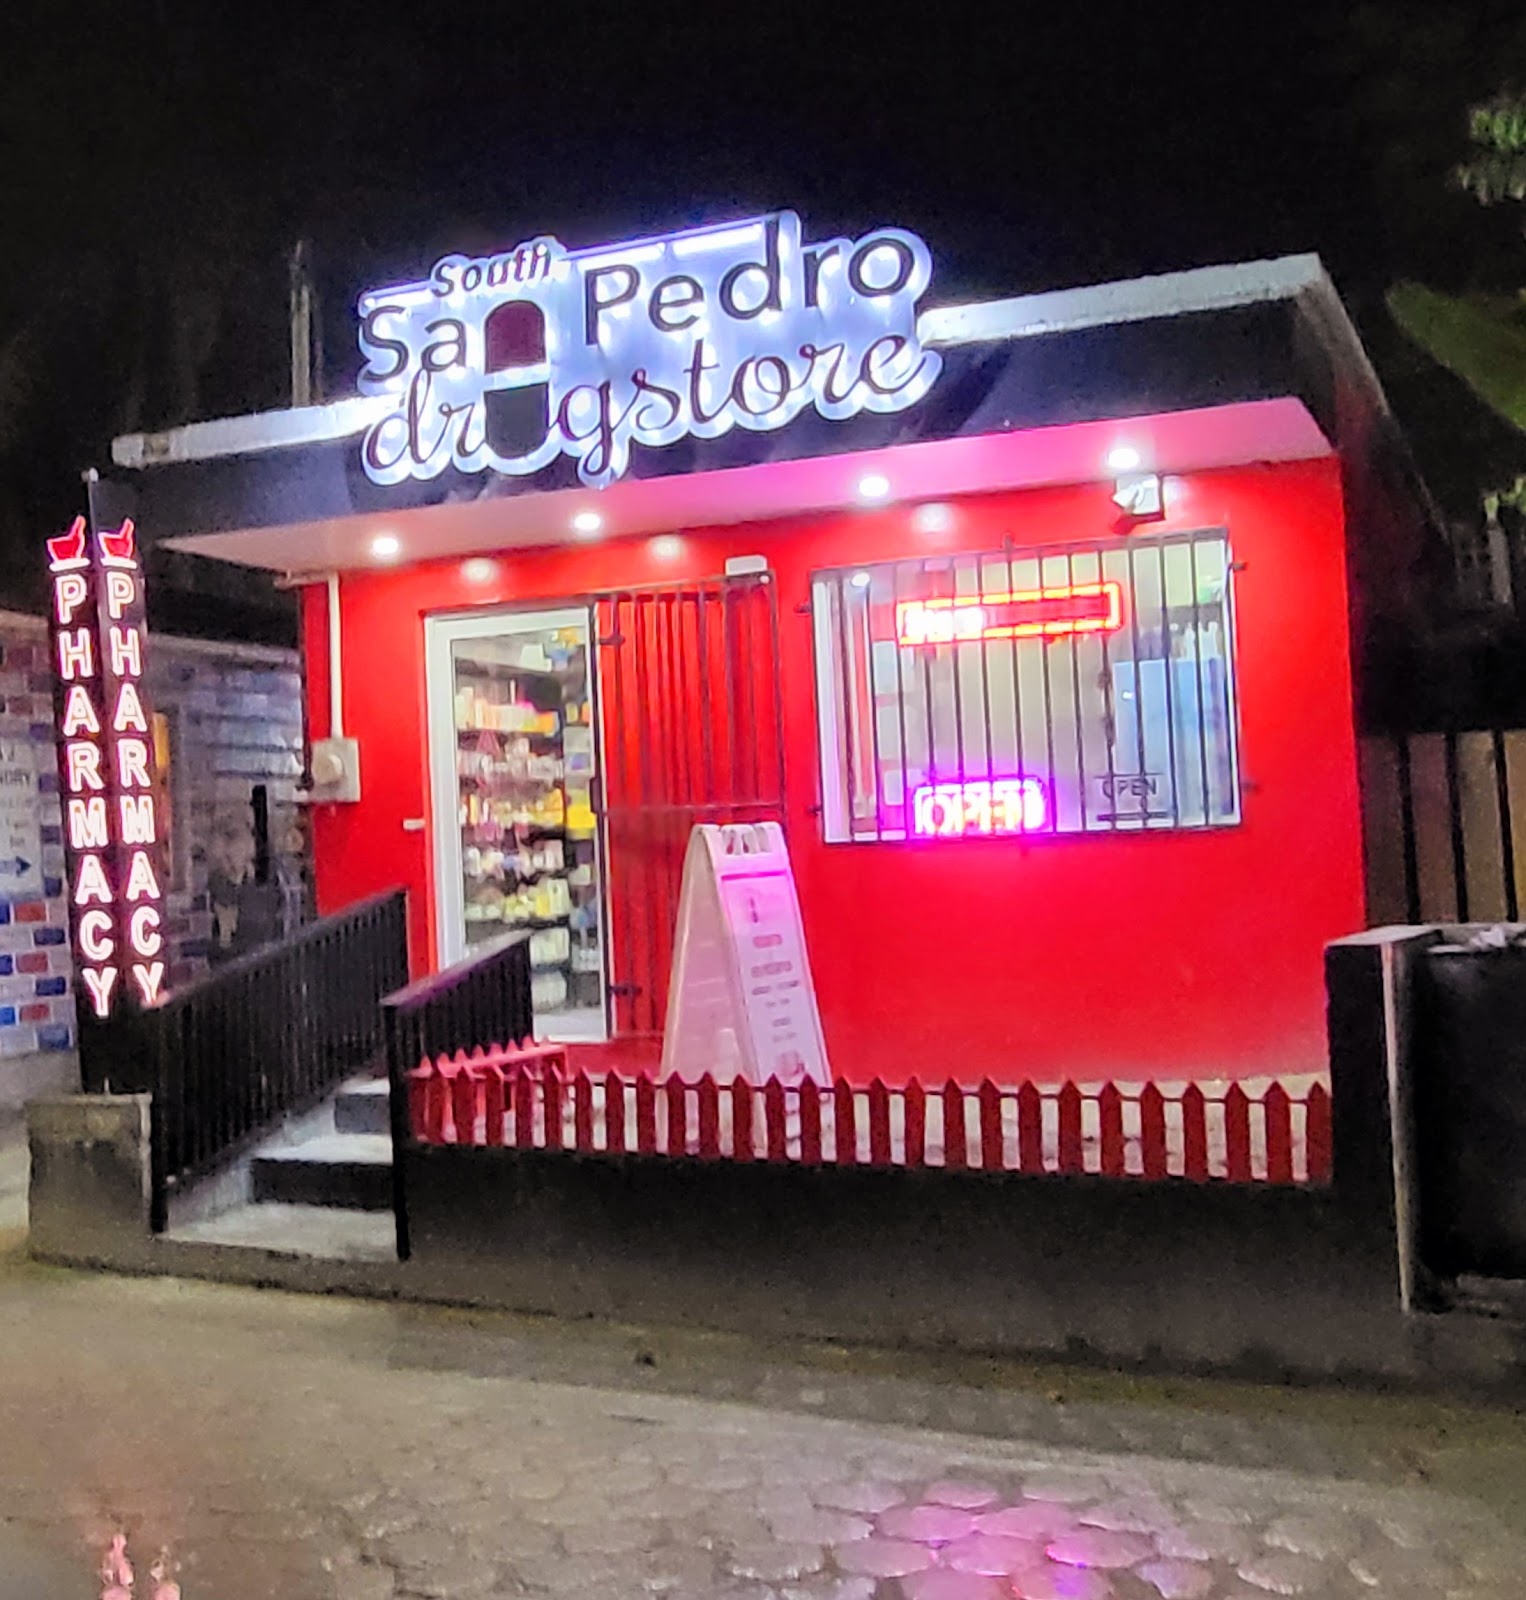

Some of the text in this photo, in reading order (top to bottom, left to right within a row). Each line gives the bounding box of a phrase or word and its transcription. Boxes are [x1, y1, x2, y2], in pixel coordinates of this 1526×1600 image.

[430, 241, 552, 298] South
[584, 218, 916, 346] Pedro
[53, 573, 118, 1018] PHARMACY
[105, 570, 167, 1008] PHARMACY
[1102, 777, 1158, 799] OPEN
